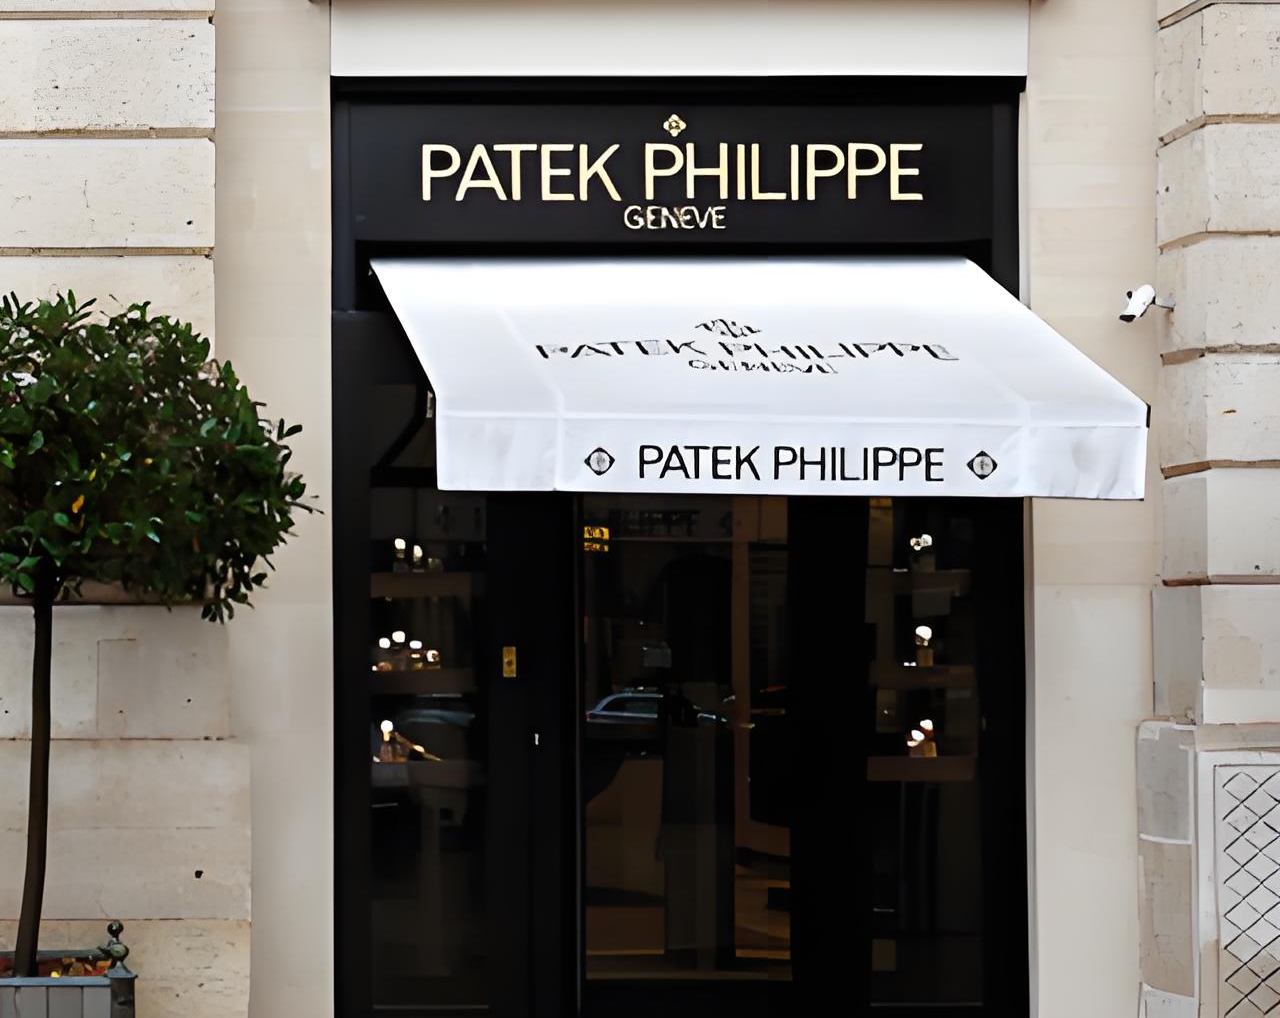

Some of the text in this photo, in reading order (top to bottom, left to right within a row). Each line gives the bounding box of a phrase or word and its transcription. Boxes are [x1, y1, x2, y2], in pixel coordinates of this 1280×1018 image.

[422, 143, 923, 201] PATEK PHILIPPE
[639, 445, 944, 481] PATEK PHILIPPE
